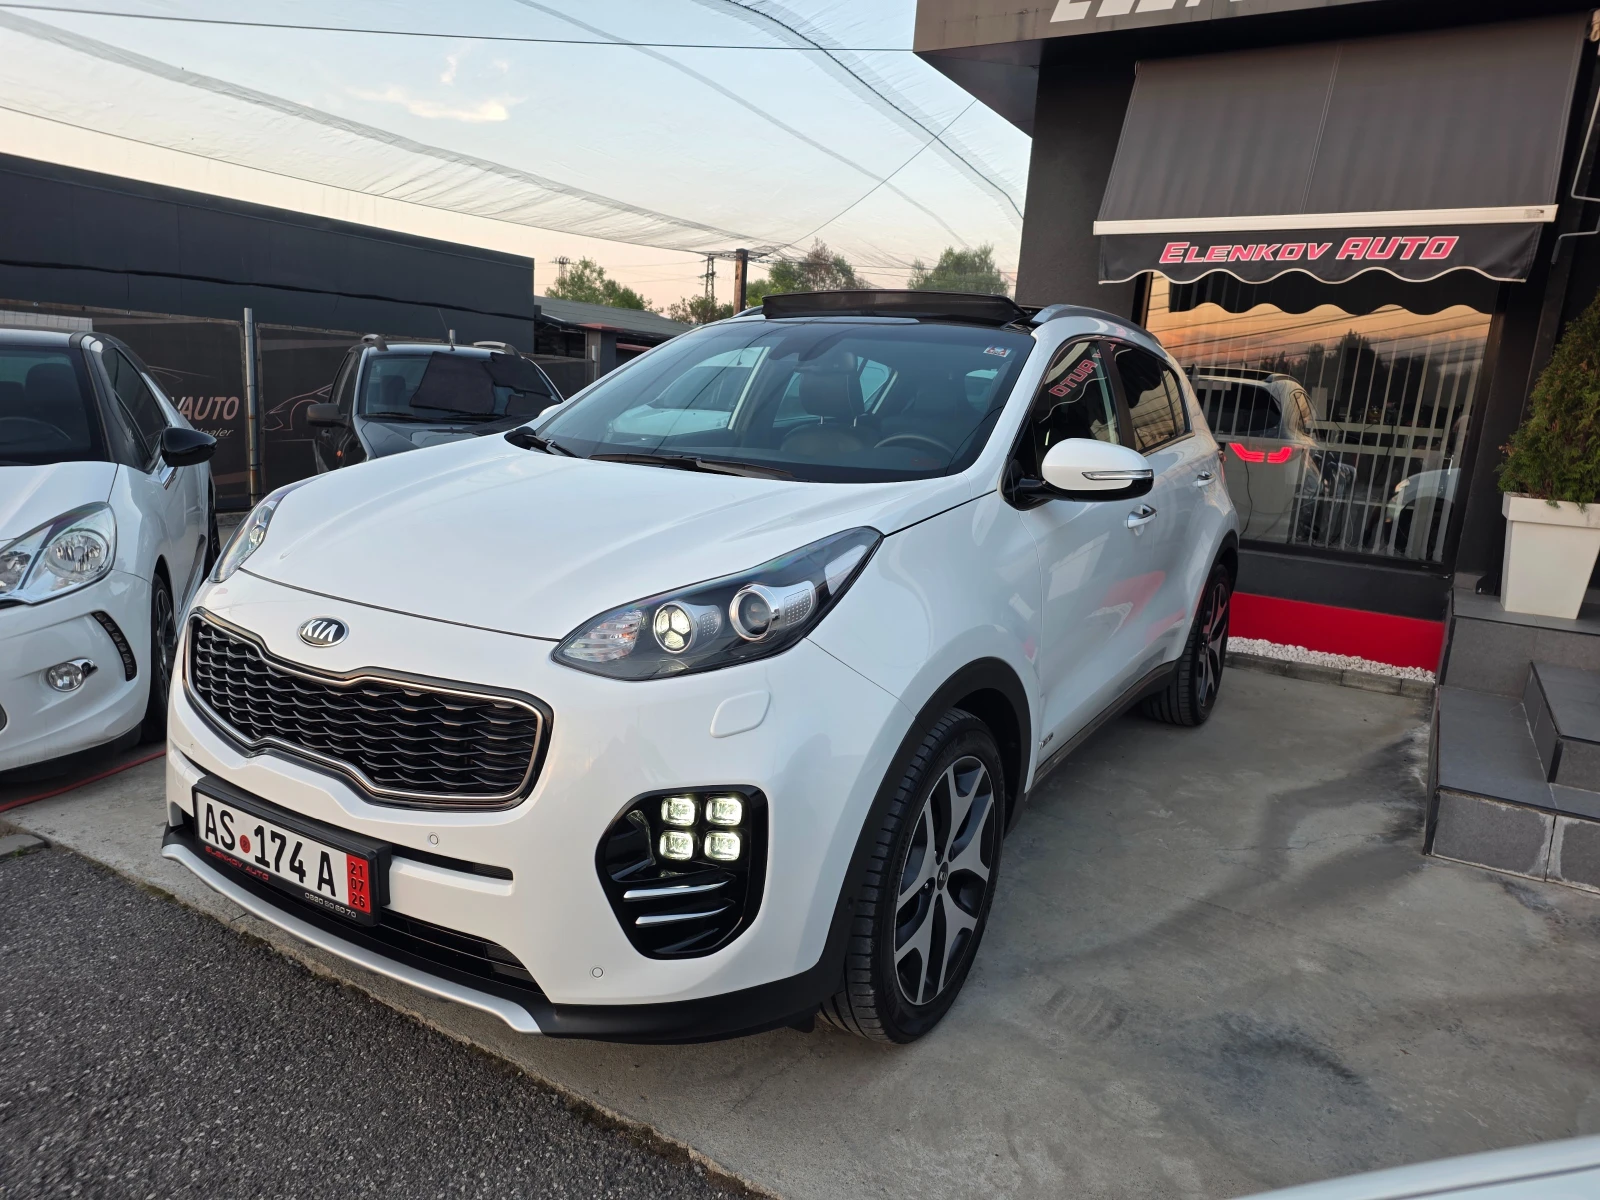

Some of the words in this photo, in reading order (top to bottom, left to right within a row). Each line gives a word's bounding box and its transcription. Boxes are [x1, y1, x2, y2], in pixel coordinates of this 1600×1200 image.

[1335, 236, 1459, 260] AUTO
[301, 619, 339, 642] KIA
[205, 803, 236, 851] AS
[254, 825, 307, 884] 174
[317, 850, 337, 898] A
[350, 862, 363, 878] 21
[350, 877, 365, 893] 07
[351, 892, 366, 908] 26
